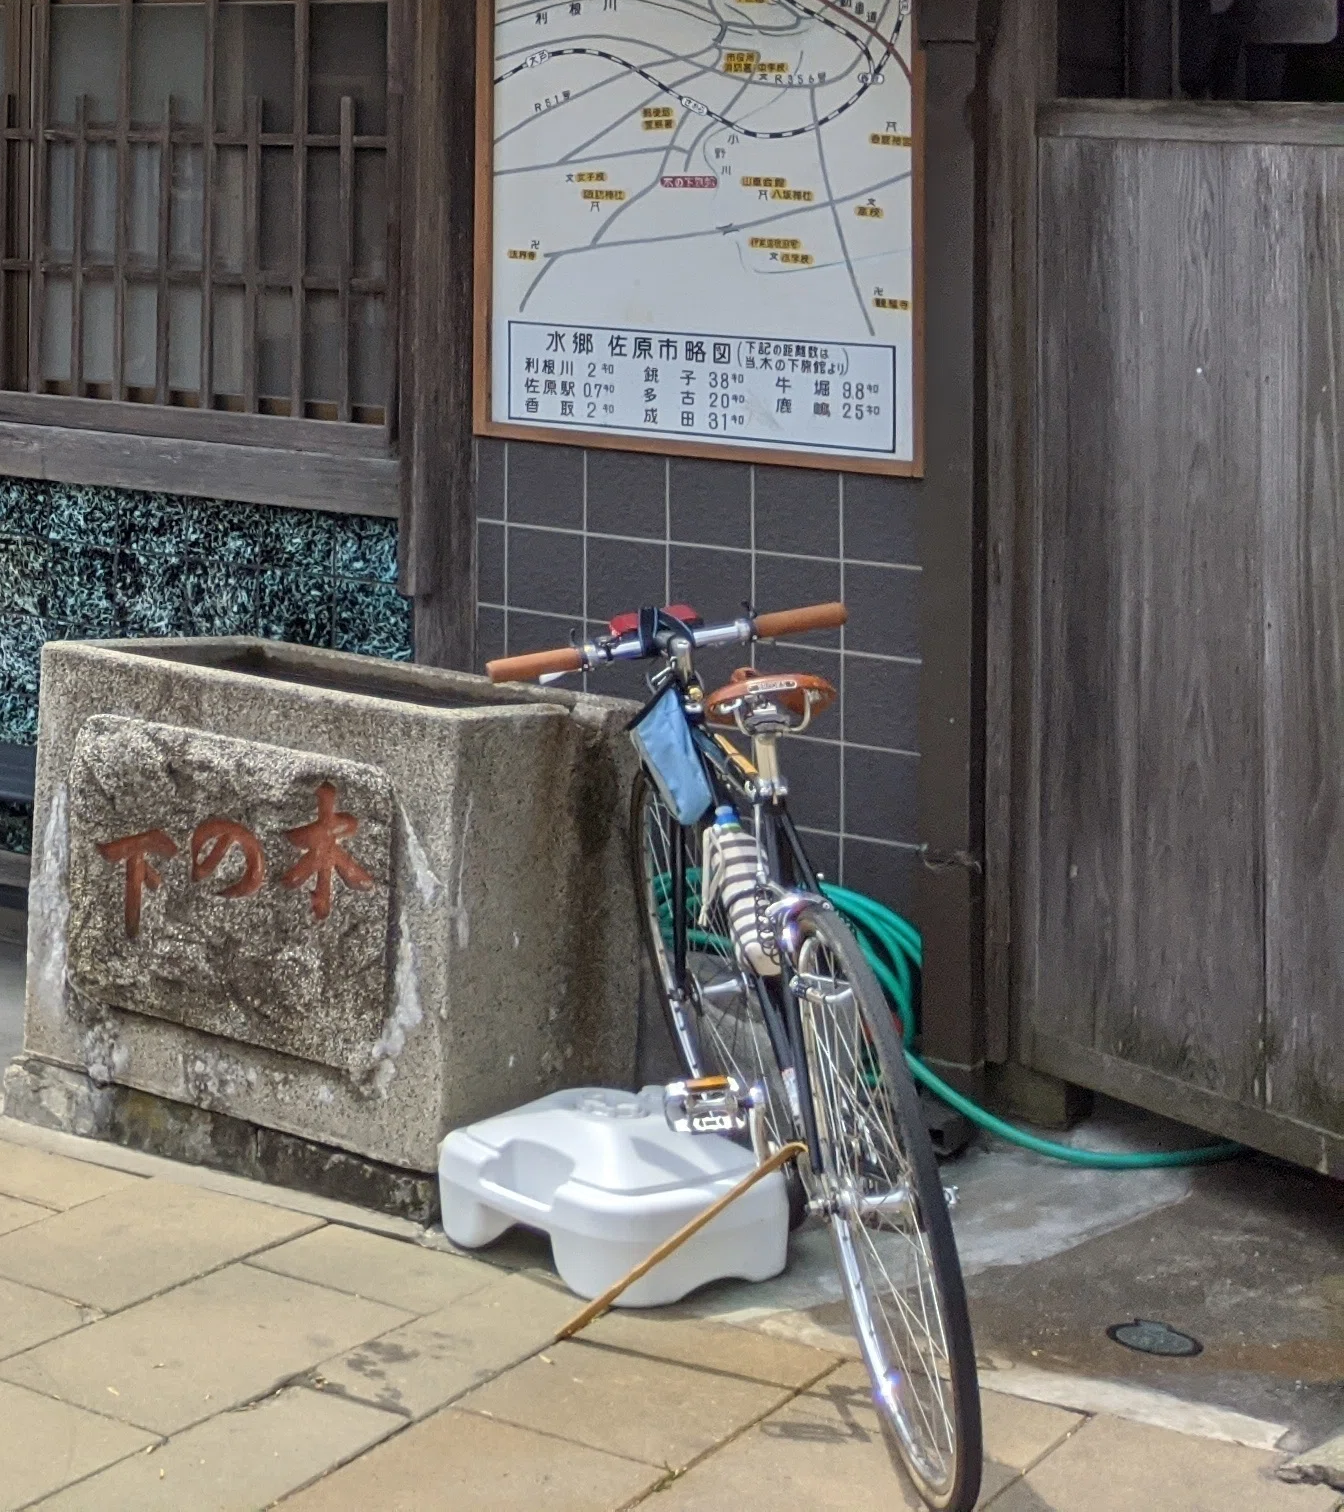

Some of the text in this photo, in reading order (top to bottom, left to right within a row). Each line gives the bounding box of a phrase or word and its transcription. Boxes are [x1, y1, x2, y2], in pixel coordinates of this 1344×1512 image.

[546, 331, 731, 364] 水郷 佐原市略図
[525, 357, 573, 376] 利根川
[525, 377, 575, 397] 佐原駅
[643, 387, 696, 406] 多古
[525, 397, 575, 417] 香取
[643, 408, 695, 427] 成田
